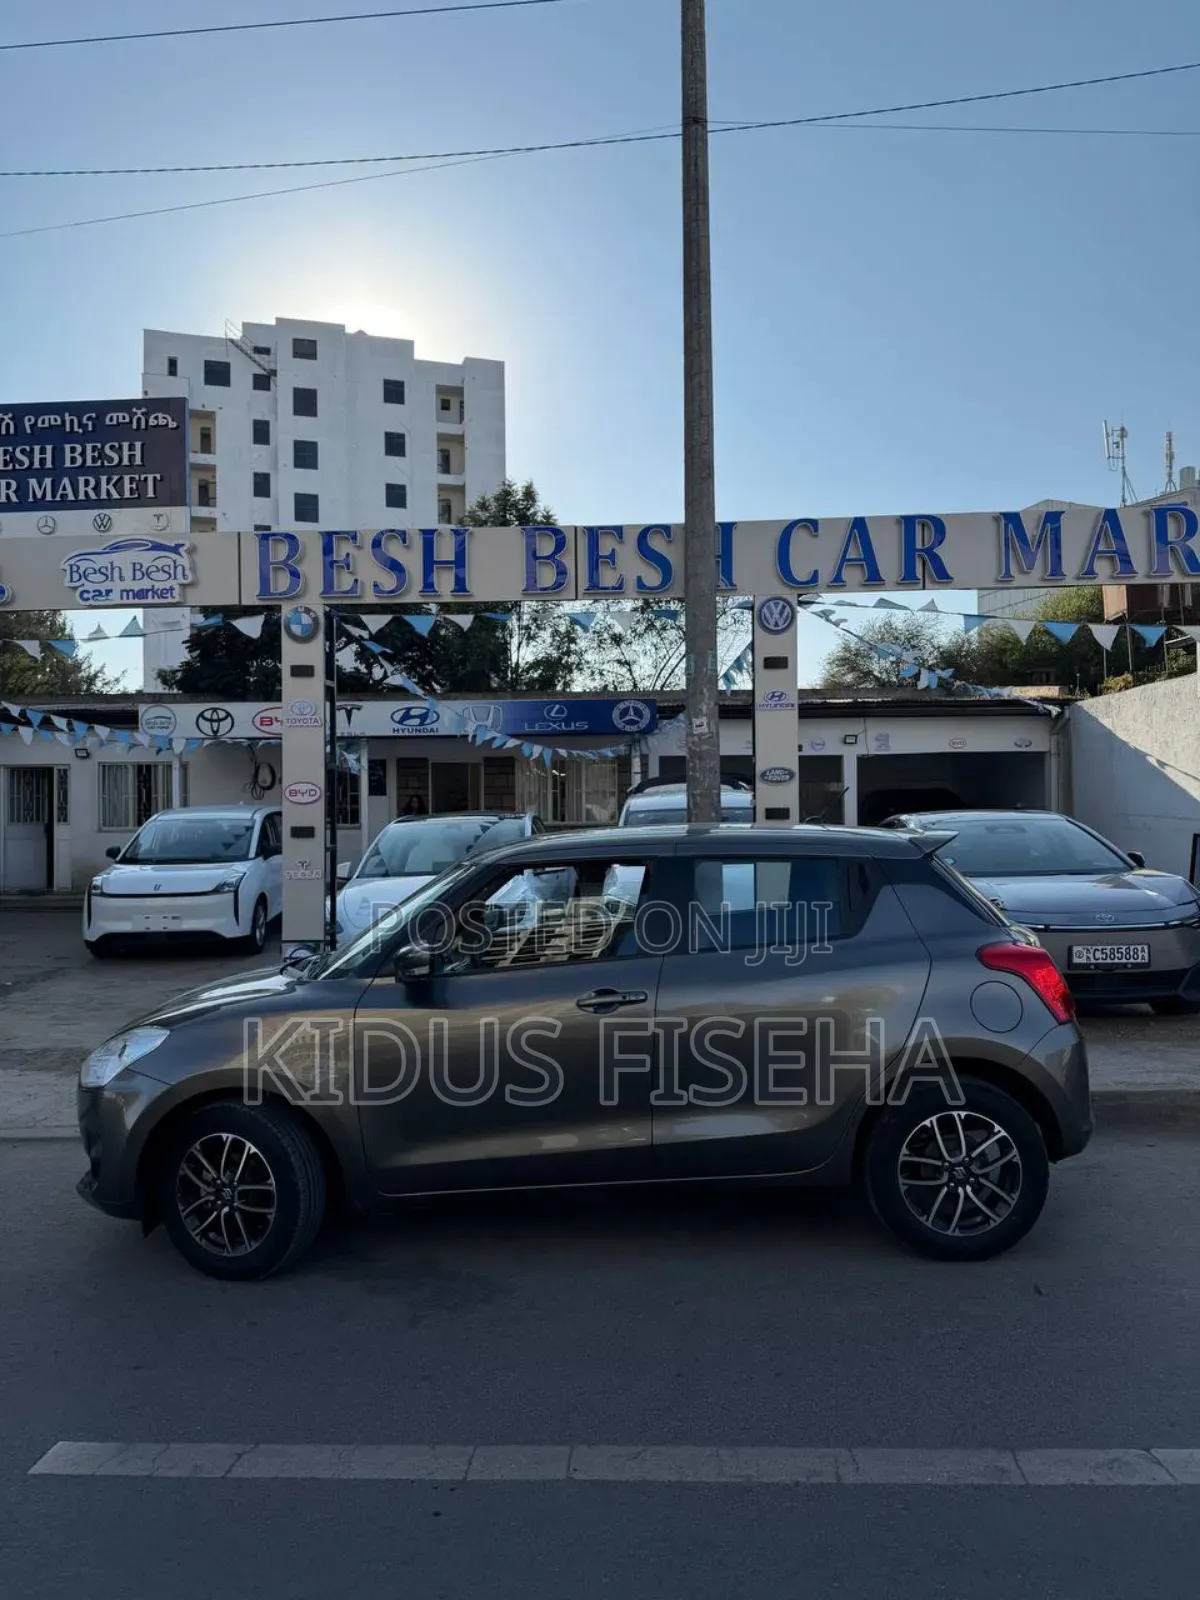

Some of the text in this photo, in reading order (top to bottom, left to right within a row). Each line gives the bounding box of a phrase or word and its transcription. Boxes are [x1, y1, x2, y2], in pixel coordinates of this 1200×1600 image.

[64, 441, 143, 468] BESH
[27, 474, 161, 502] MARKET
[254, 528, 472, 598] BESH
[776, 513, 955, 588] CAR
[995, 503, 1200, 583] MAR
[69, 555, 188, 584] Besh Besh
[79, 585, 175, 601] car market
[525, 721, 589, 731] LEXUS
[289, 789, 317, 797] BYD
[1093, 947, 1140, 961] C58588
